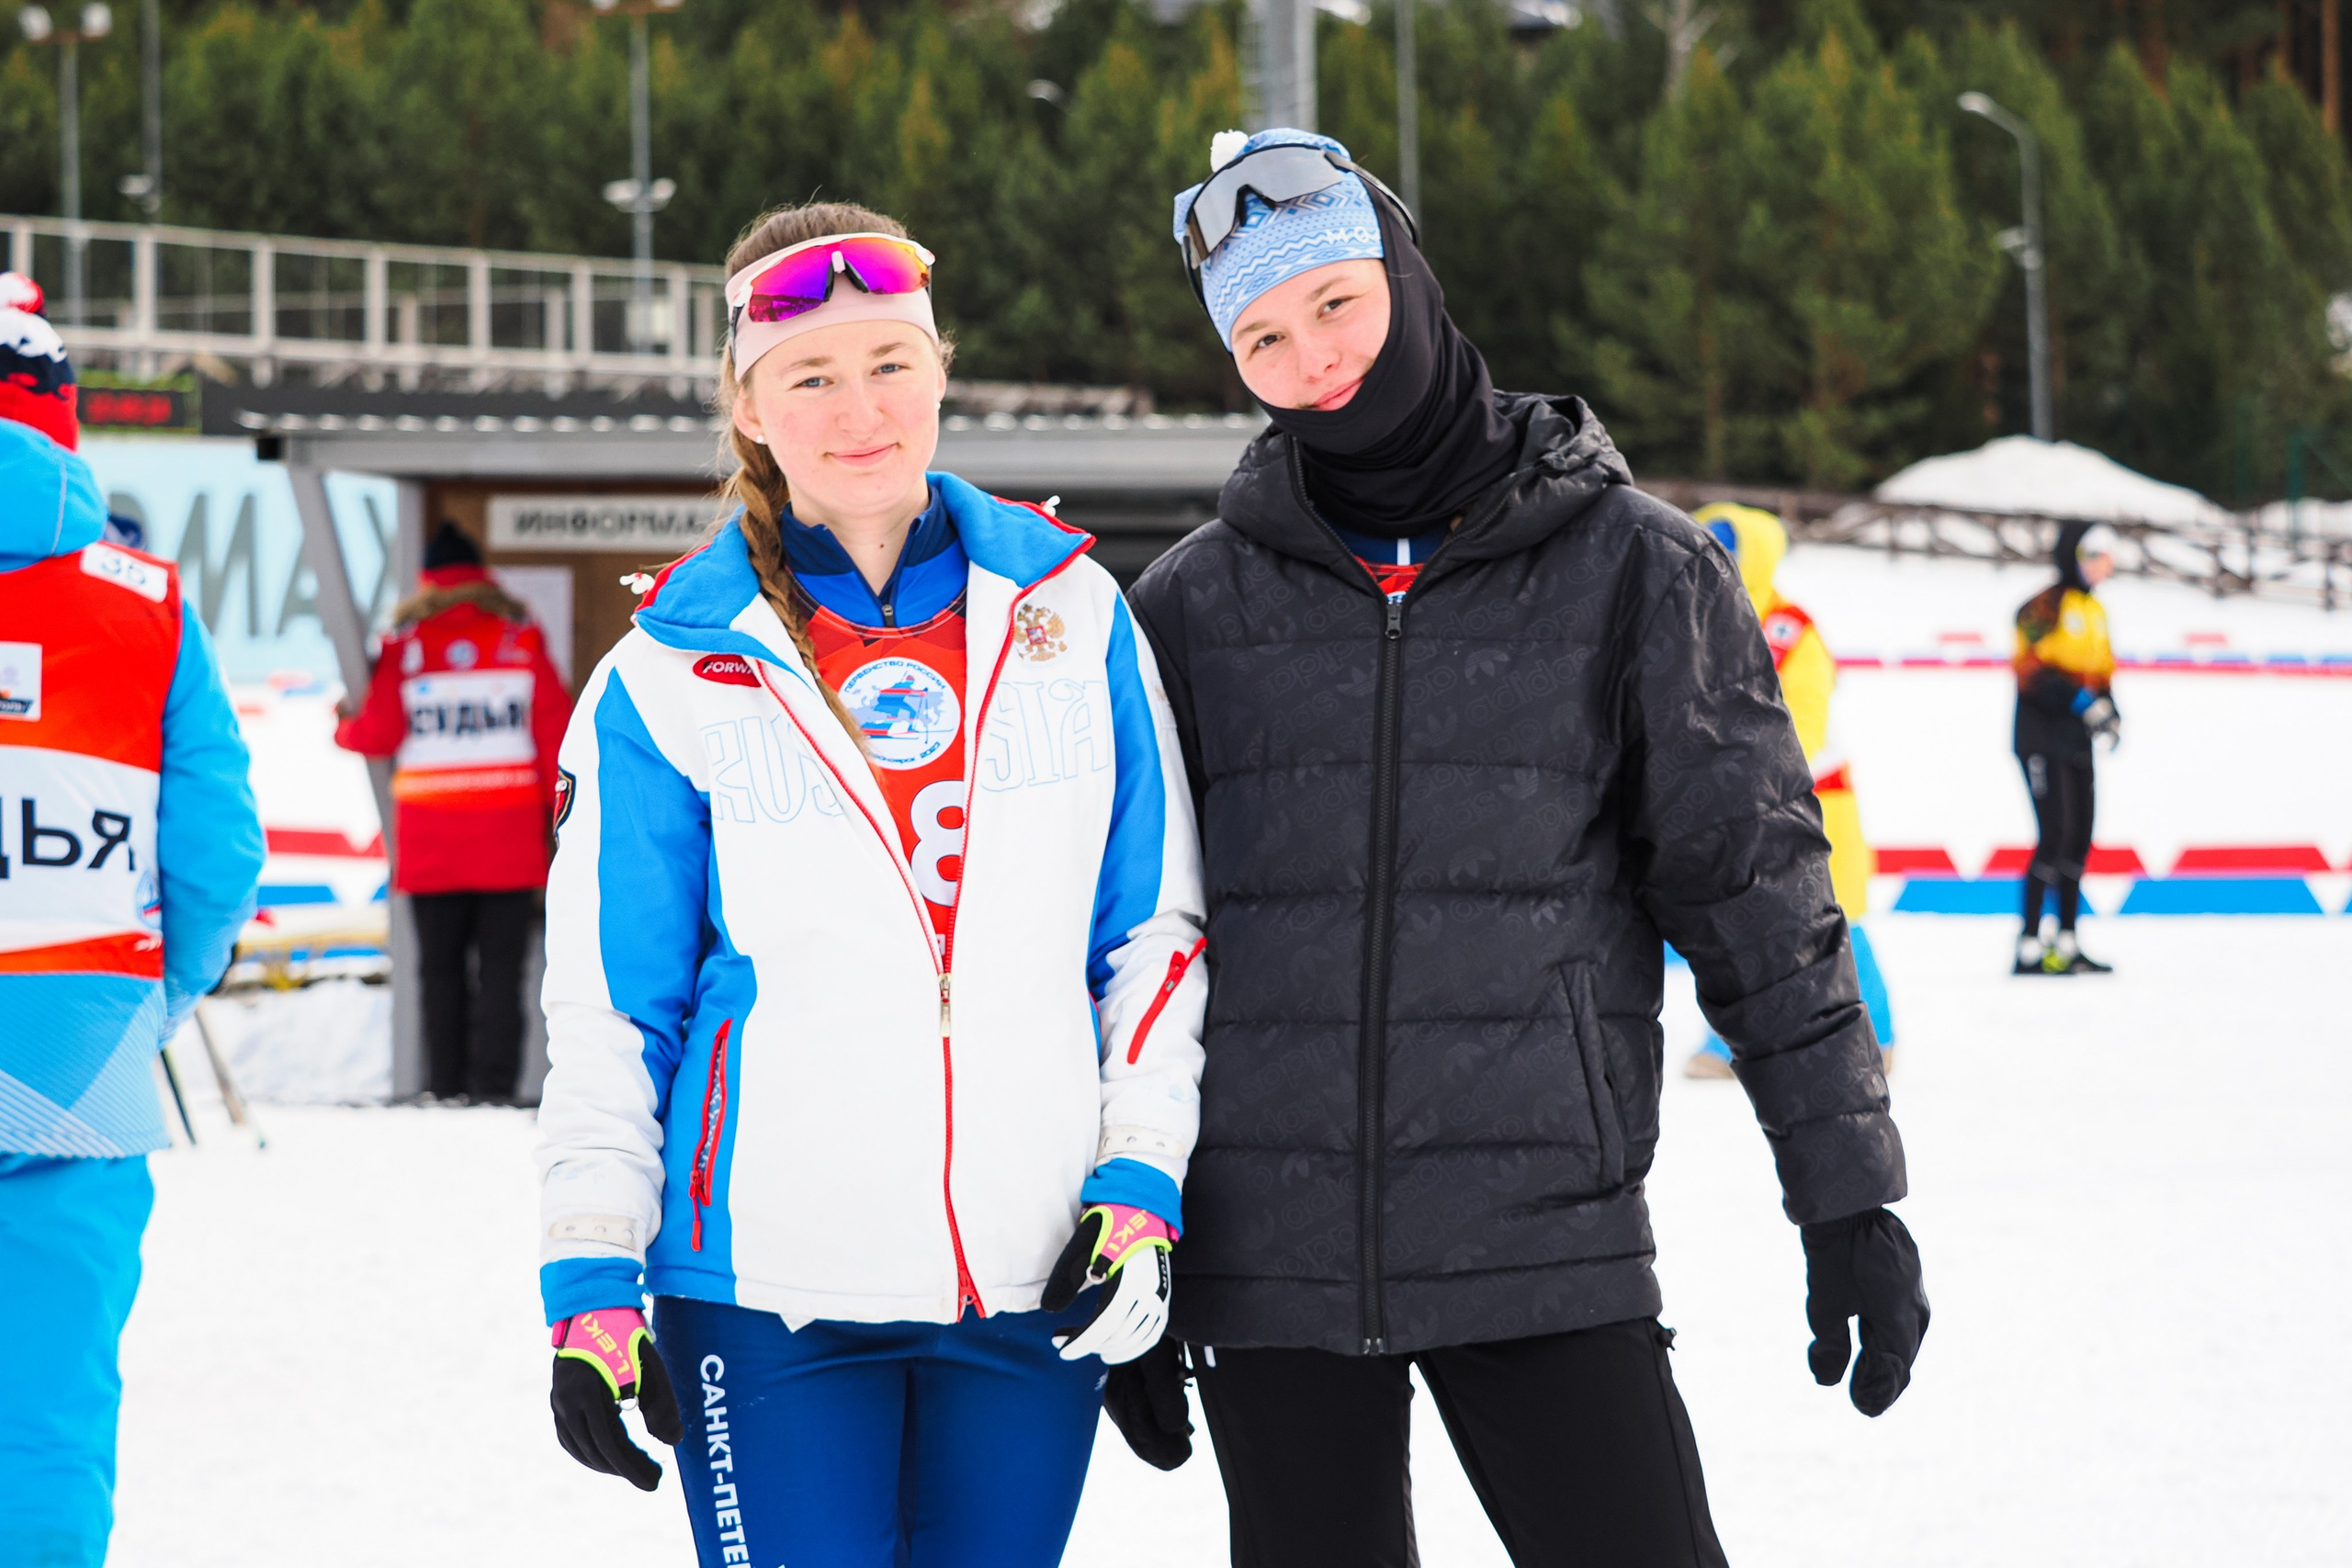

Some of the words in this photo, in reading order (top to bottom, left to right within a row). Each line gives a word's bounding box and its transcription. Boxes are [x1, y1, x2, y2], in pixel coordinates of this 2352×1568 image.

[843, 660, 904, 694] ПЕРВЕНСТВО
[907, 662, 946, 690] РОССИИ
[0, 795, 136, 879] ЬЯ
[700, 1354, 751, 1568] САНКТ-ПЕТЕ
